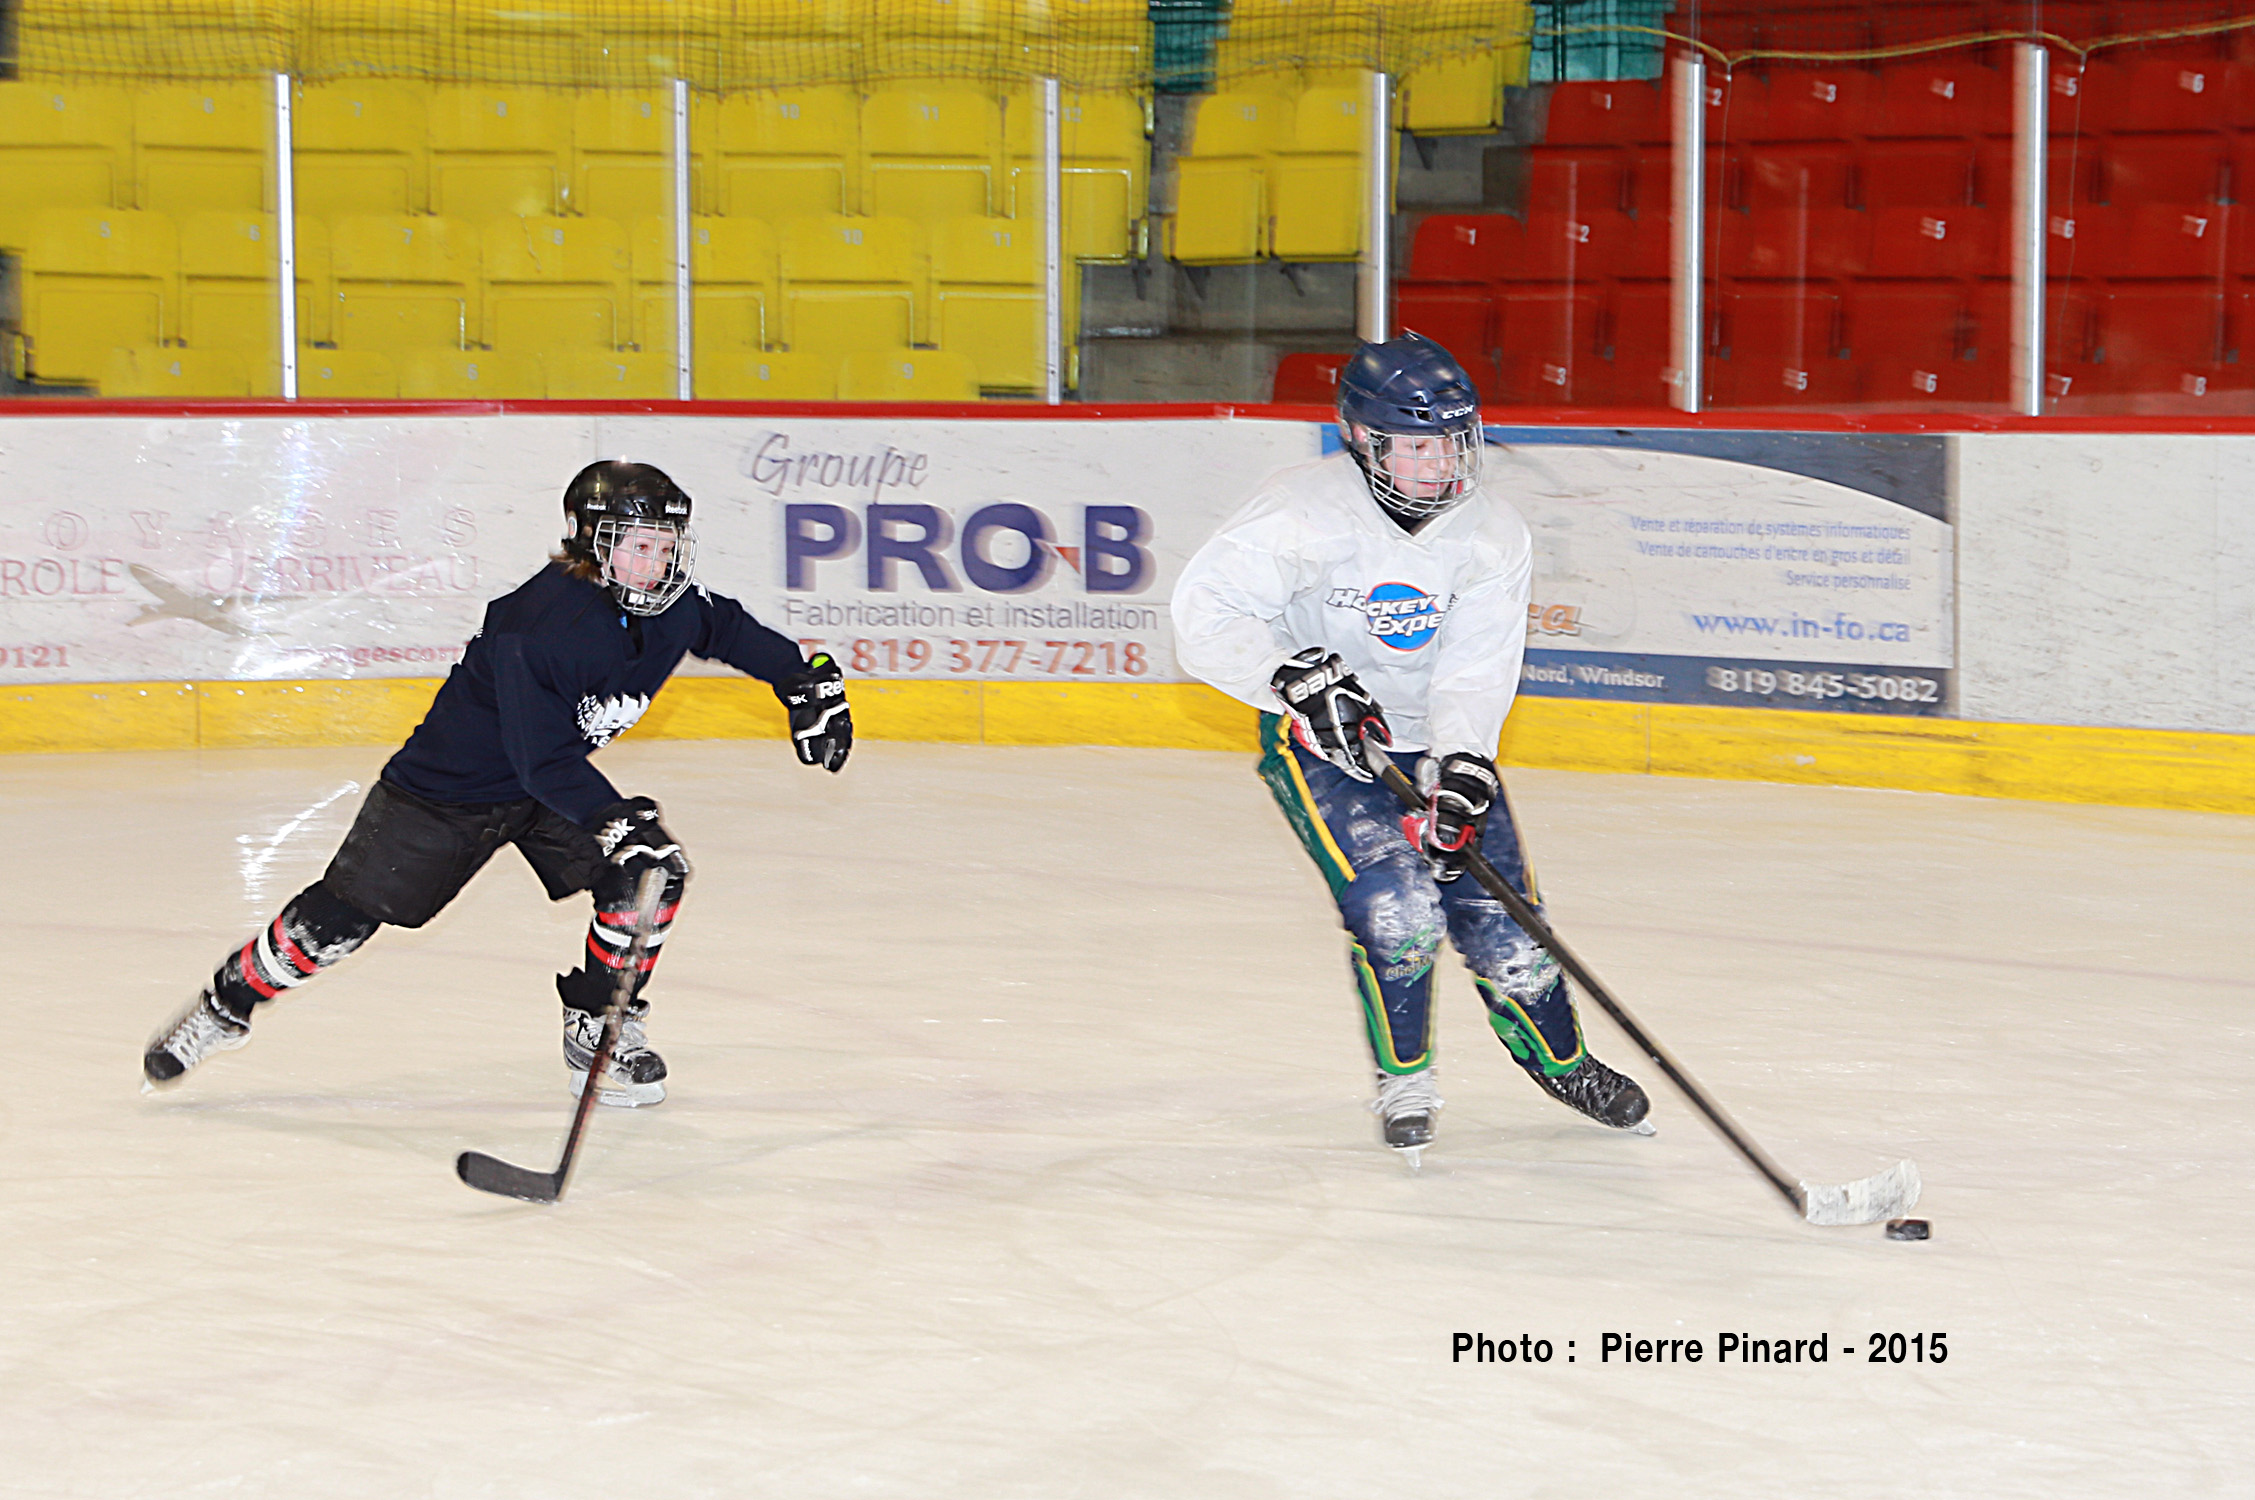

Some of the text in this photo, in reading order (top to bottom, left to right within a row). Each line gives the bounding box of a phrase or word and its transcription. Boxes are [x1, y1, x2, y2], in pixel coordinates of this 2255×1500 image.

[750, 434, 929, 505] Groupe
[1631, 516, 1911, 541] Vente et réparation de systèmes informatiques
[1640, 540, 1674, 557] Vente
[1677, 542, 1692, 558] de
[1694, 542, 1761, 560] cartouches
[1831, 549, 1858, 567] gros
[1861, 549, 1874, 563] et
[1786, 569, 1911, 592] Service personnalisé
[785, 600, 1157, 630] Fabrication et installation
[1692, 611, 1911, 643] www.in-fo.ca
[851, 638, 933, 674] 819
[948, 639, 1148, 676] 377-7218
[1715, 667, 1939, 704] 819 845-5082
